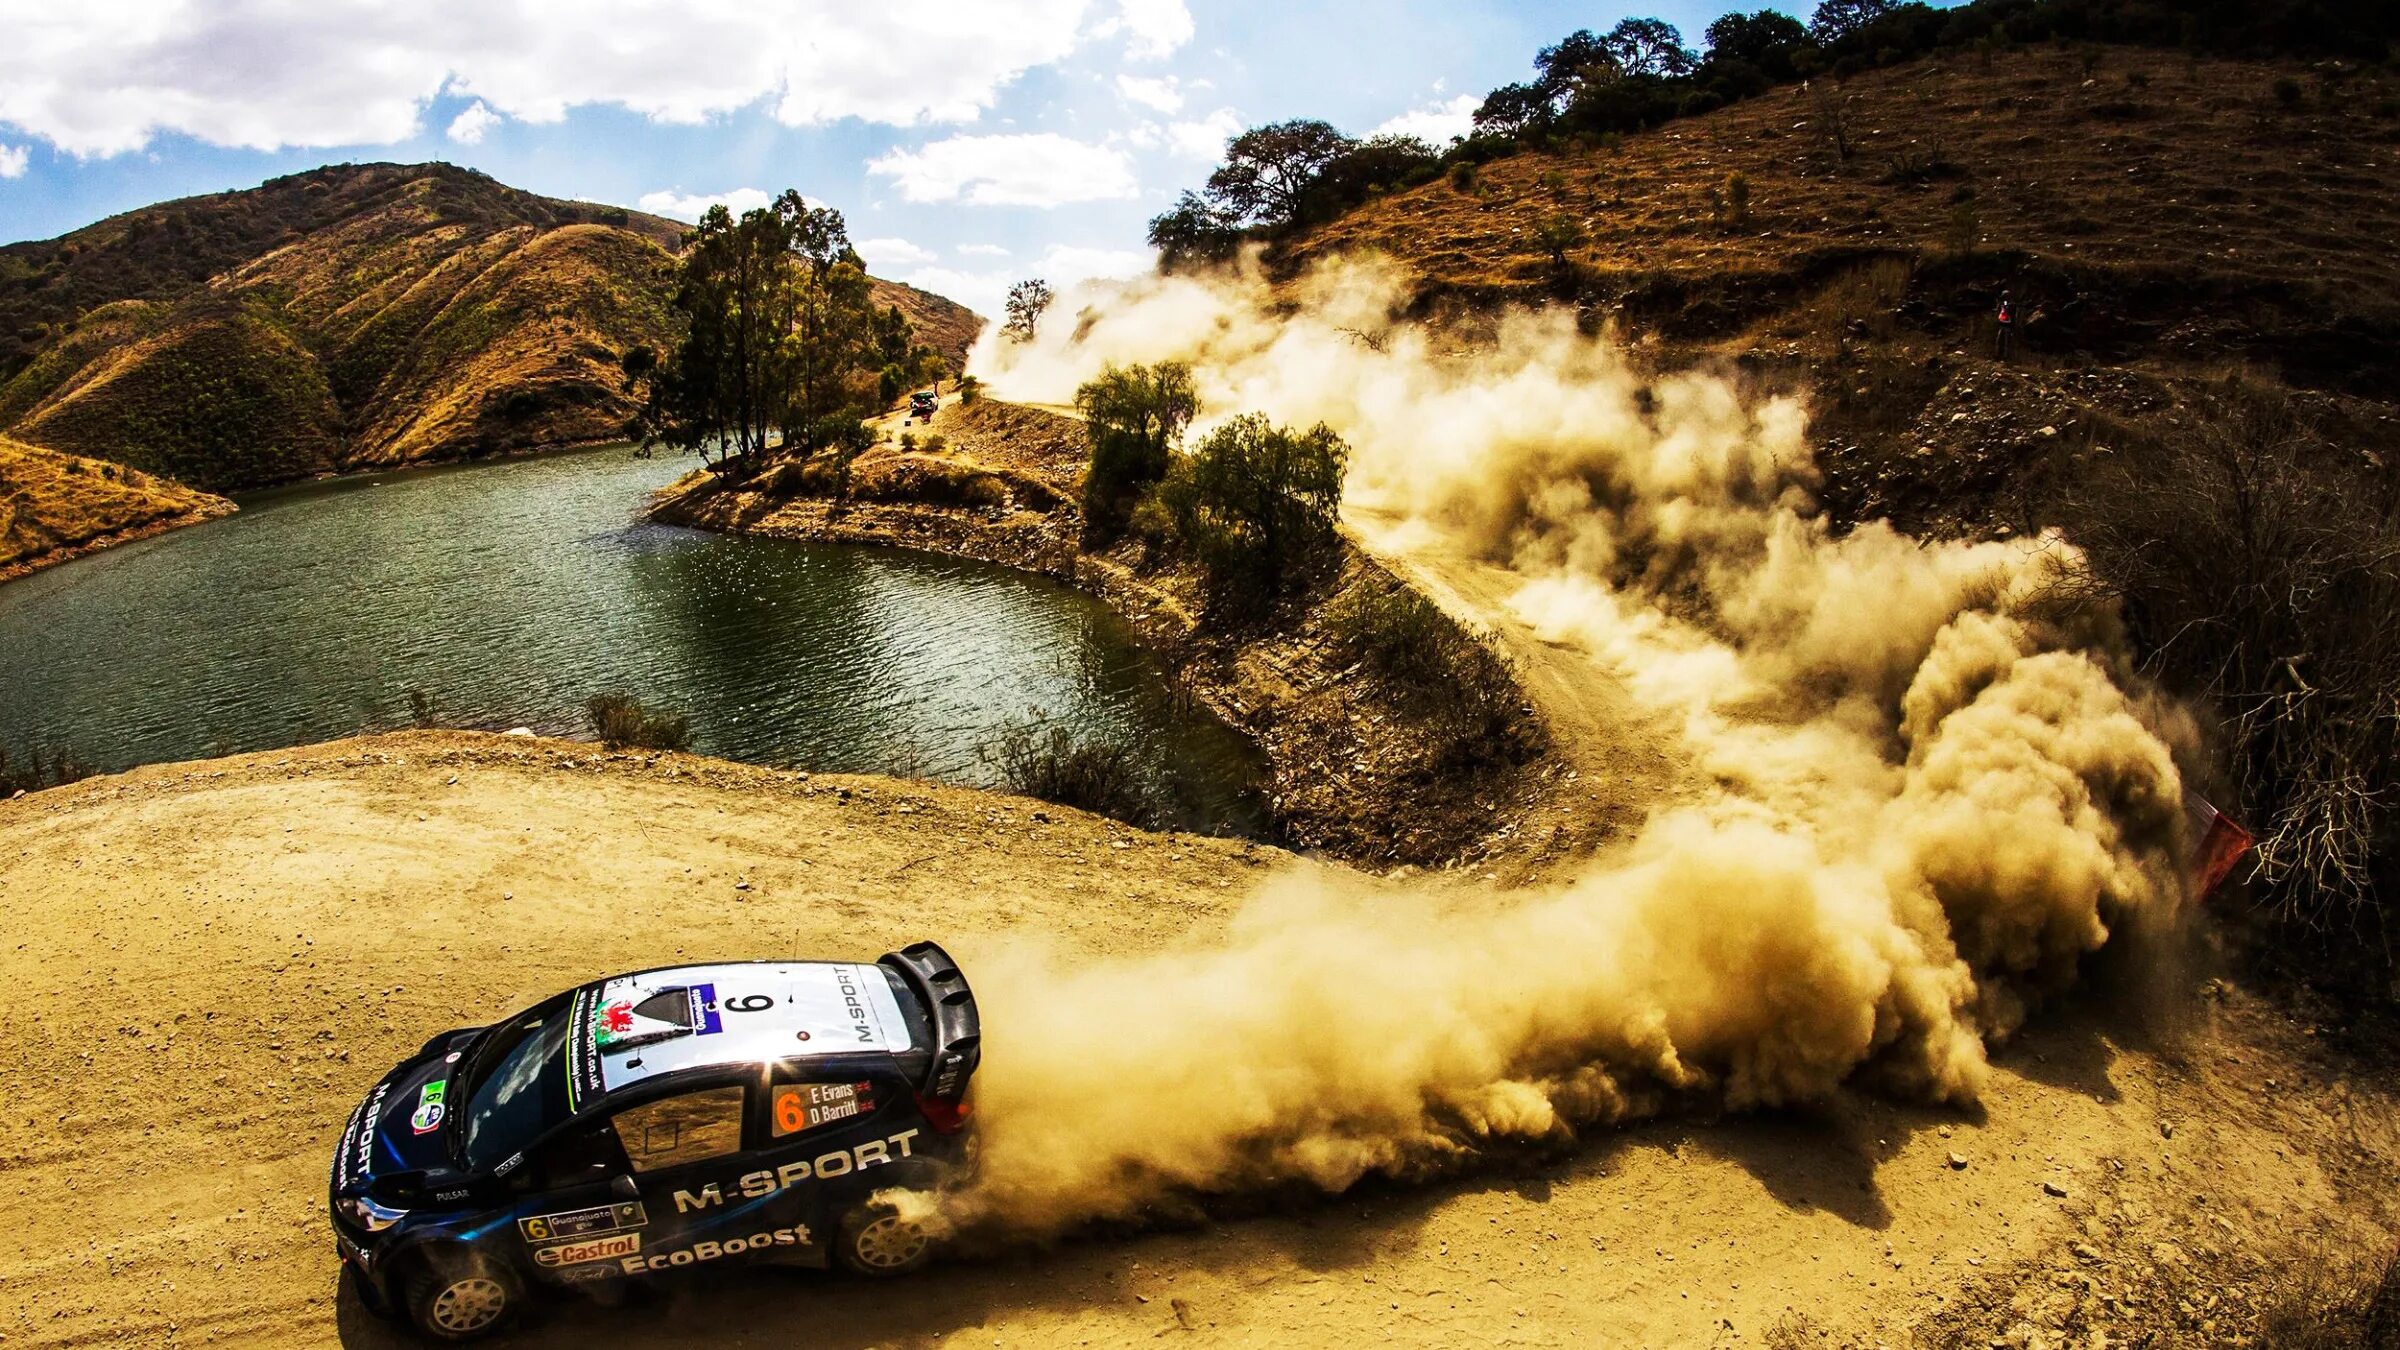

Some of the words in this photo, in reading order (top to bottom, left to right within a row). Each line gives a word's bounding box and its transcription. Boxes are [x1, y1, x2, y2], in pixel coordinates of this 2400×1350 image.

[725, 994, 774, 1013] 6
[833, 967, 873, 1043] M-SPORT
[425, 1092, 442, 1102] 6
[811, 1087, 821, 1105] E
[822, 1082, 853, 1102] Evans
[776, 1092, 805, 1133] 6
[810, 1107, 820, 1125] D
[822, 1099, 858, 1122] Barritt
[673, 1128, 919, 1214] M-SPORT
[436, 1188, 470, 1201] PULSAR
[527, 1218, 548, 1239] 6
[551, 1209, 611, 1226] Guanajuato
[561, 1236, 636, 1263] Castrol
[619, 1223, 814, 1275] EcoBoost
